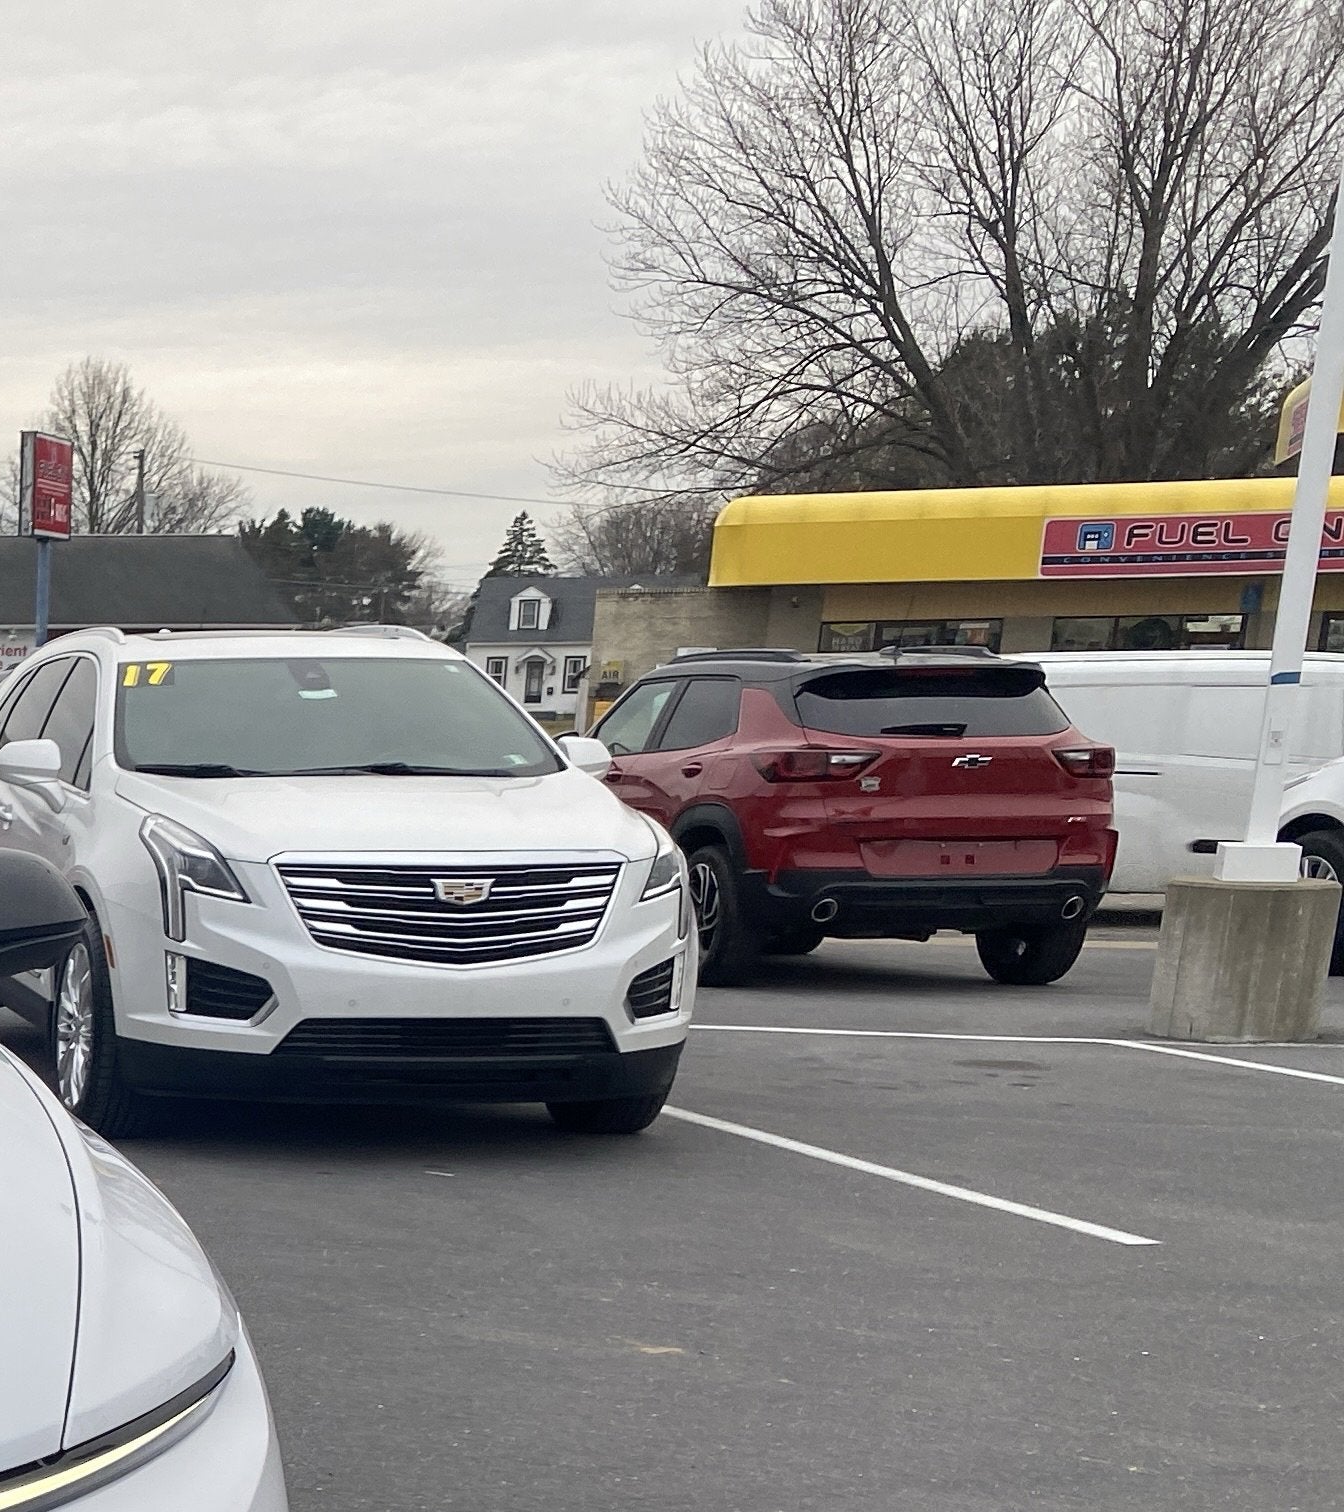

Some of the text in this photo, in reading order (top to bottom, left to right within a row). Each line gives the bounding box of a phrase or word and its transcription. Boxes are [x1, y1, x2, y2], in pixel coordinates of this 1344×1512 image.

[1124, 520, 1252, 549] FUEL
[1063, 552, 1247, 563] CONVENIENCE
[123, 663, 172, 687] 17
[601, 670, 620, 680] AIR
